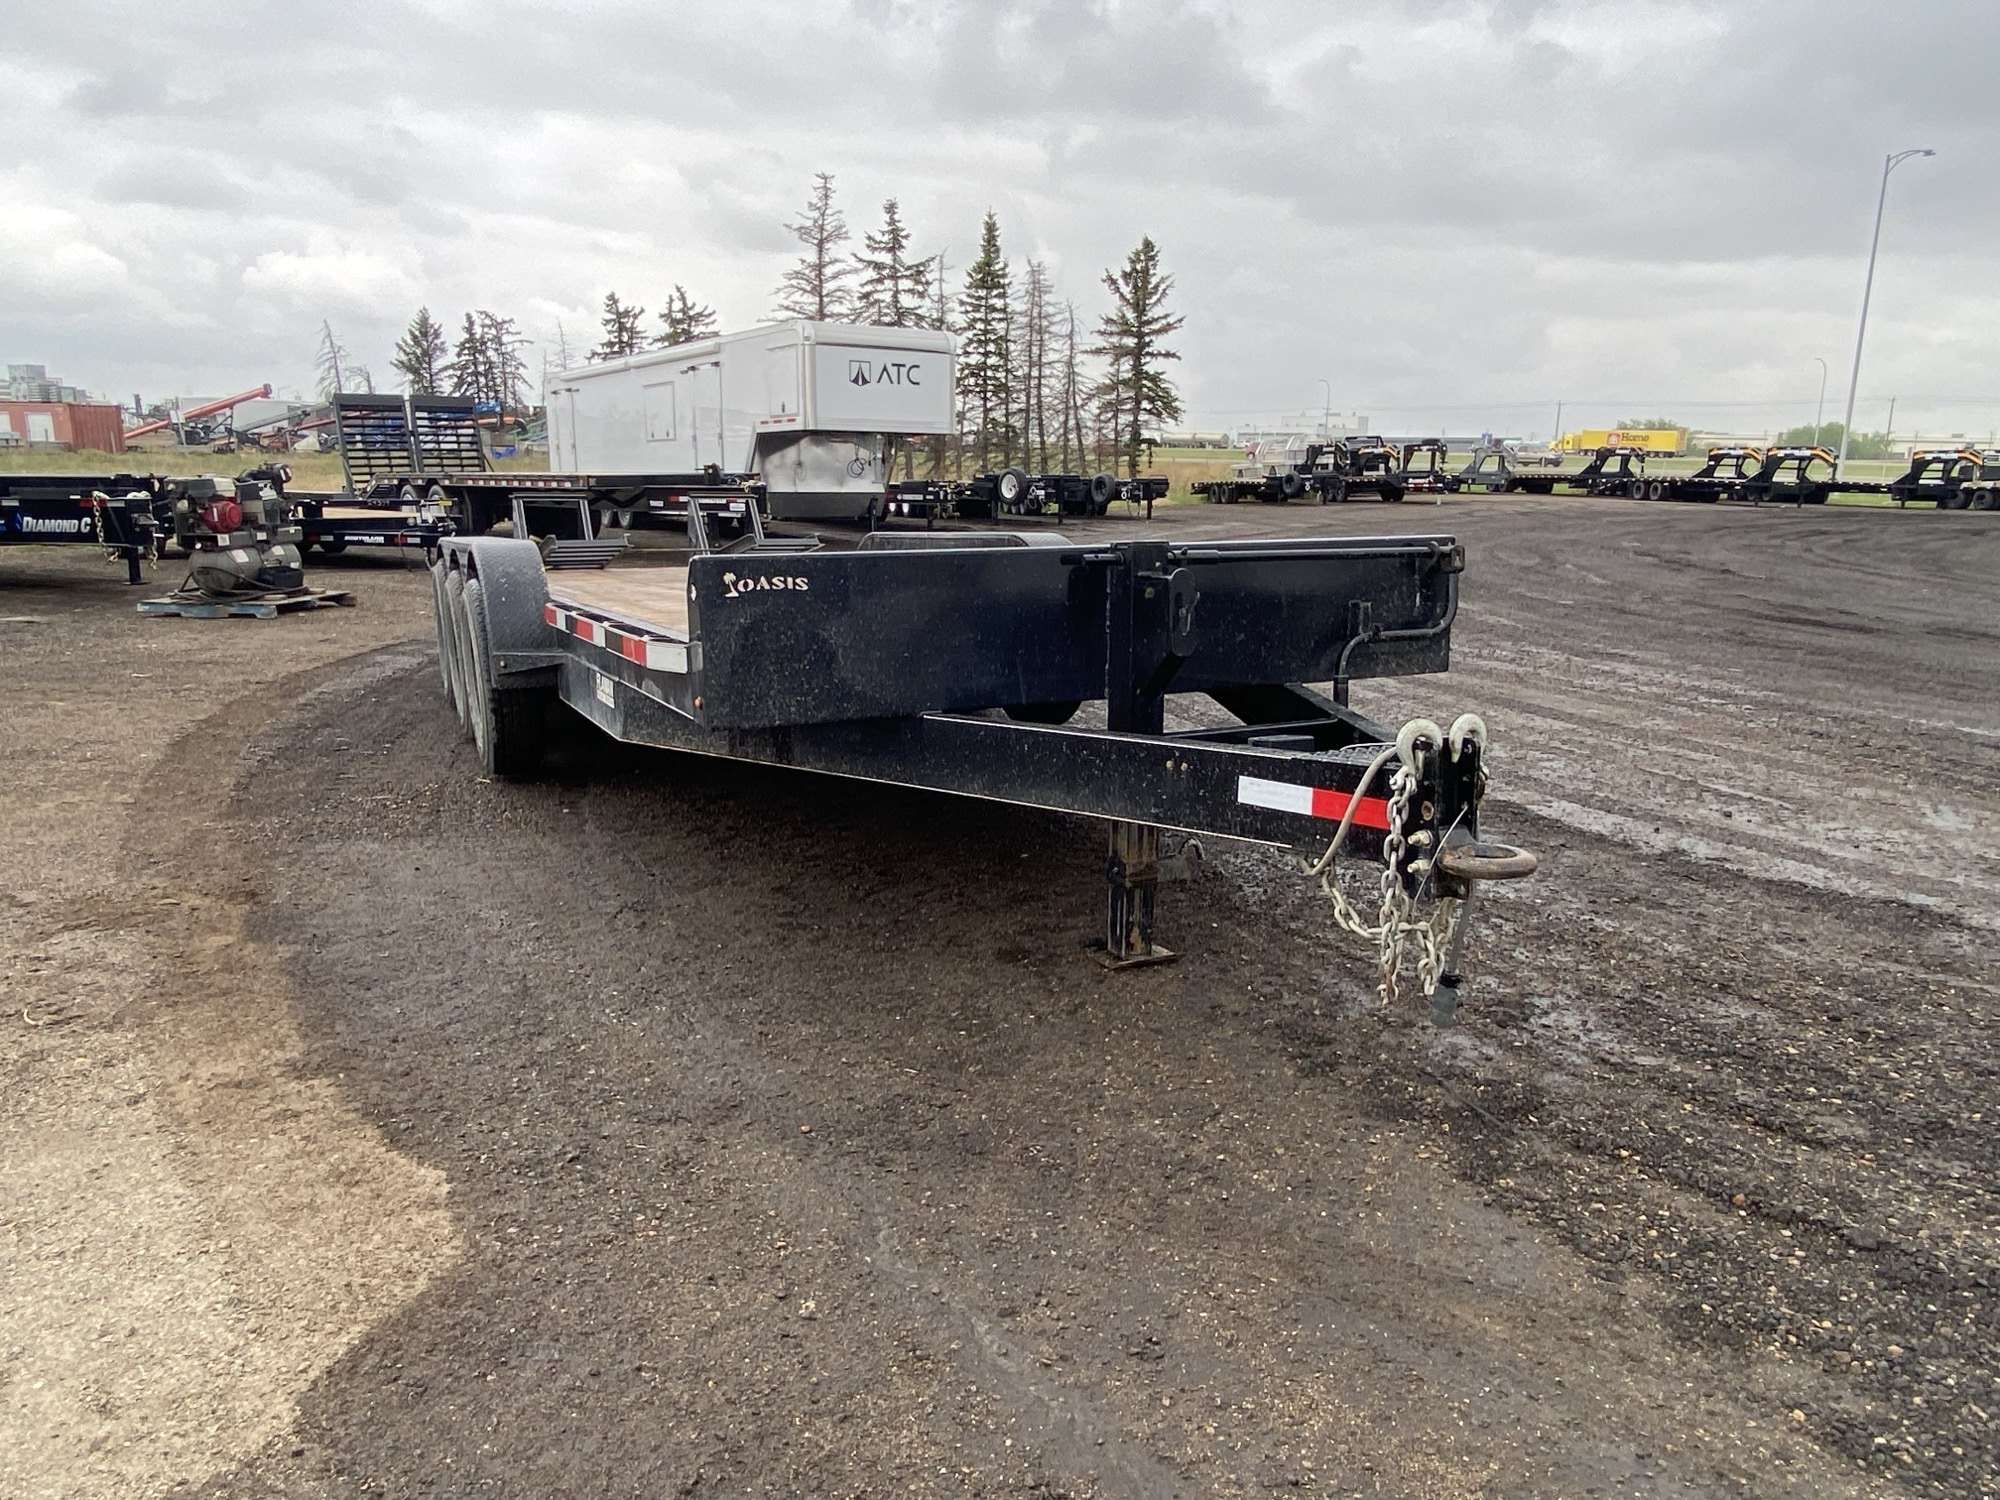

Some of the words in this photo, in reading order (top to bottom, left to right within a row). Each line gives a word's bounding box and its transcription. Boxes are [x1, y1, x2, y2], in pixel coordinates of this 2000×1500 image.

[877, 363, 920, 385] ATC
[22, 516, 79, 532] DIAMOND
[80, 517, 92, 533] C
[737, 575, 809, 592] OASIS
